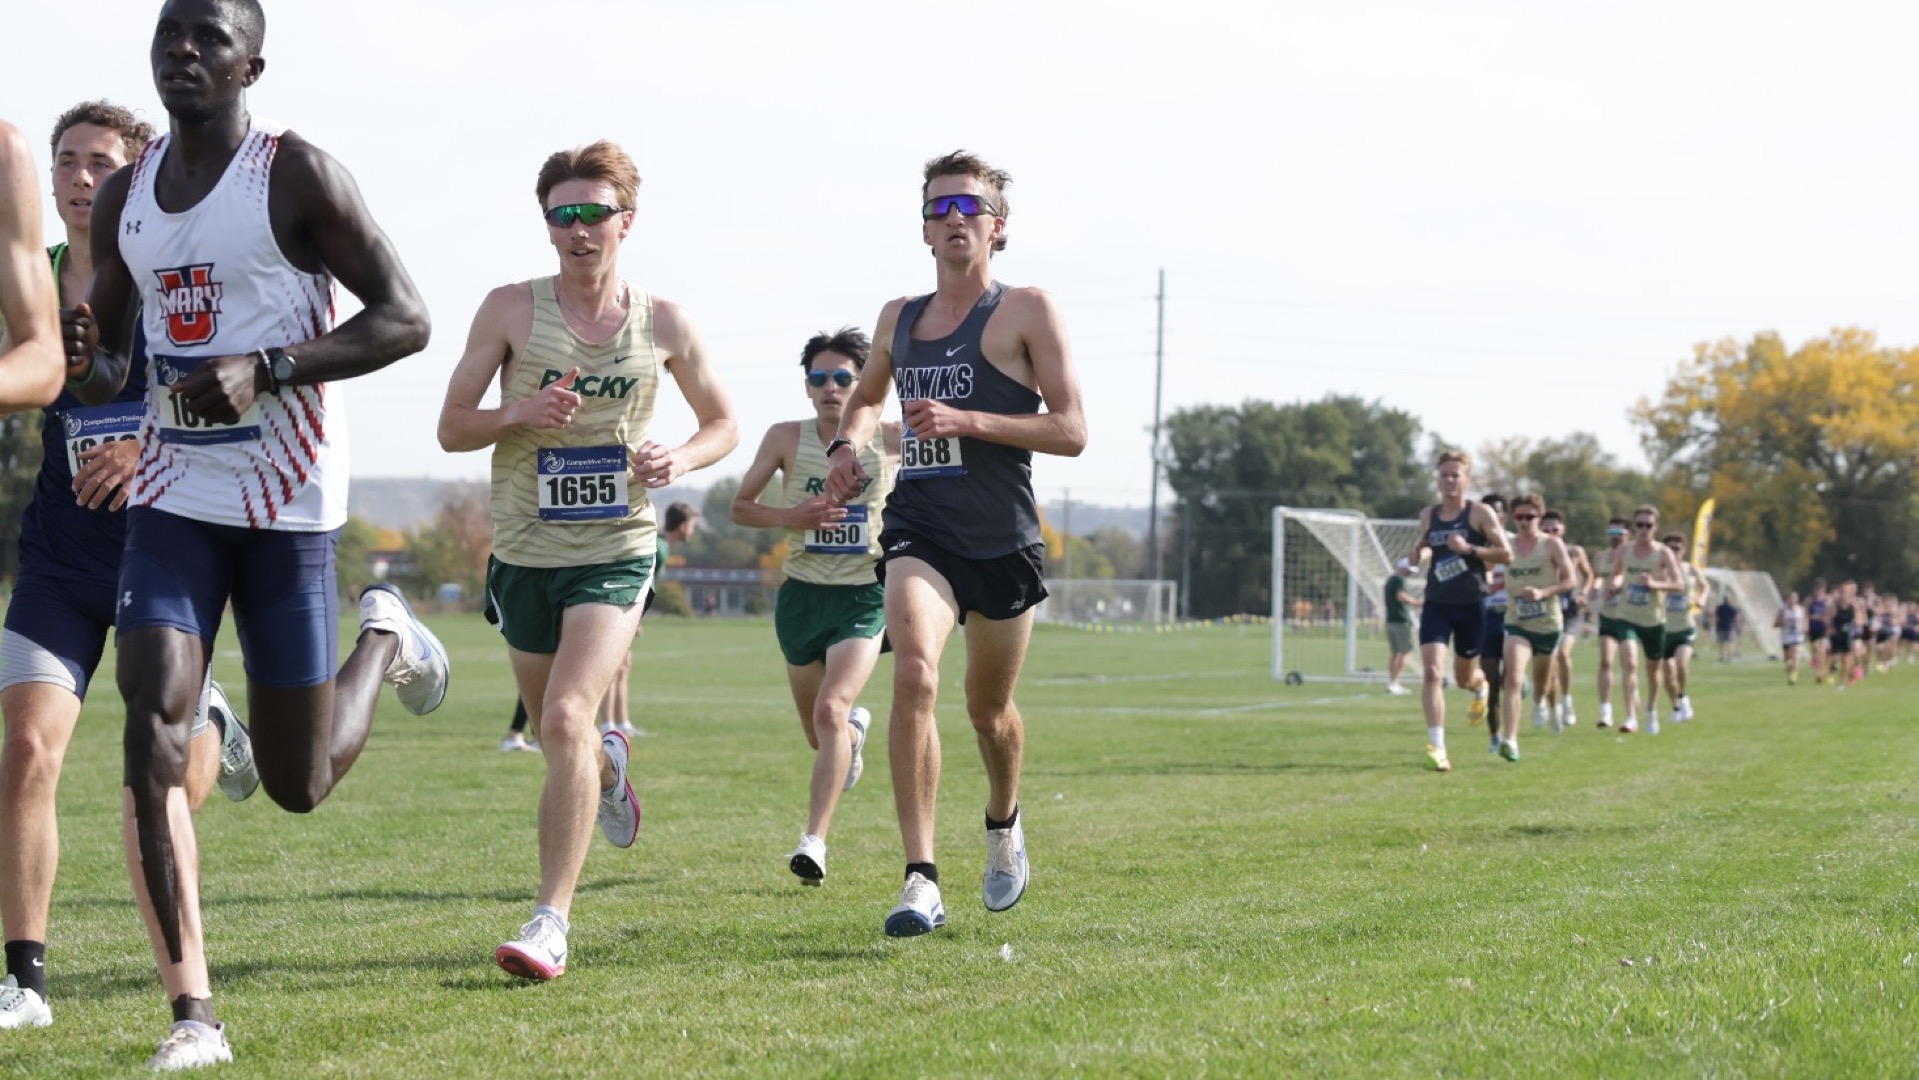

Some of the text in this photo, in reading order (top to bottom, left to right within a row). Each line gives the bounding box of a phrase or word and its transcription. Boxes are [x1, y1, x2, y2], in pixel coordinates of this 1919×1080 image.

[159, 283, 223, 318] MARY
[540, 369, 639, 398] RCKY
[546, 475, 615, 506] 1655
[814, 524, 860, 544] 1650
